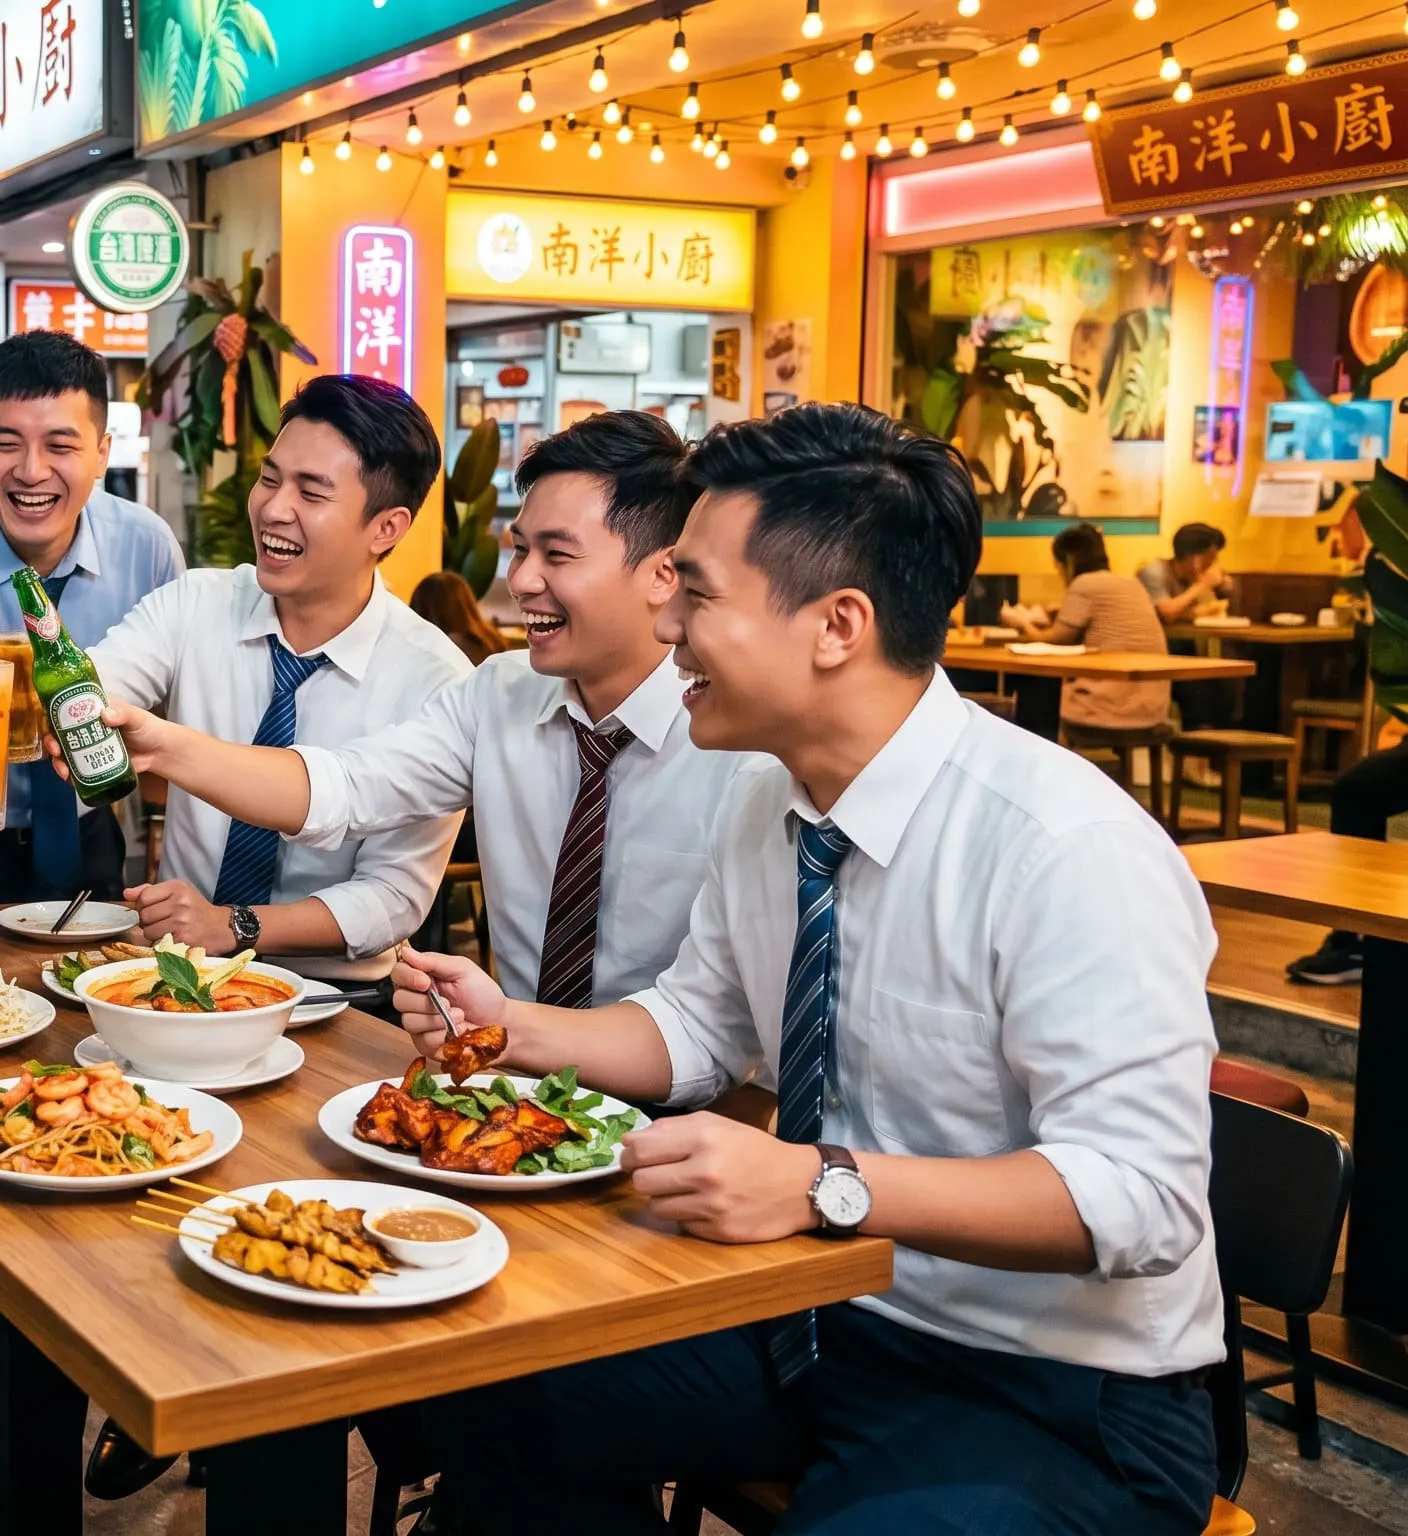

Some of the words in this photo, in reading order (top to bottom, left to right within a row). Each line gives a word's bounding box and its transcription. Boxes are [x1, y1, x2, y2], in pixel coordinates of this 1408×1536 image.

[1128, 83, 1395, 187] 南洋小廚
[542, 222, 715, 286] 南洋小廚
[355, 237, 403, 379] 南洋
